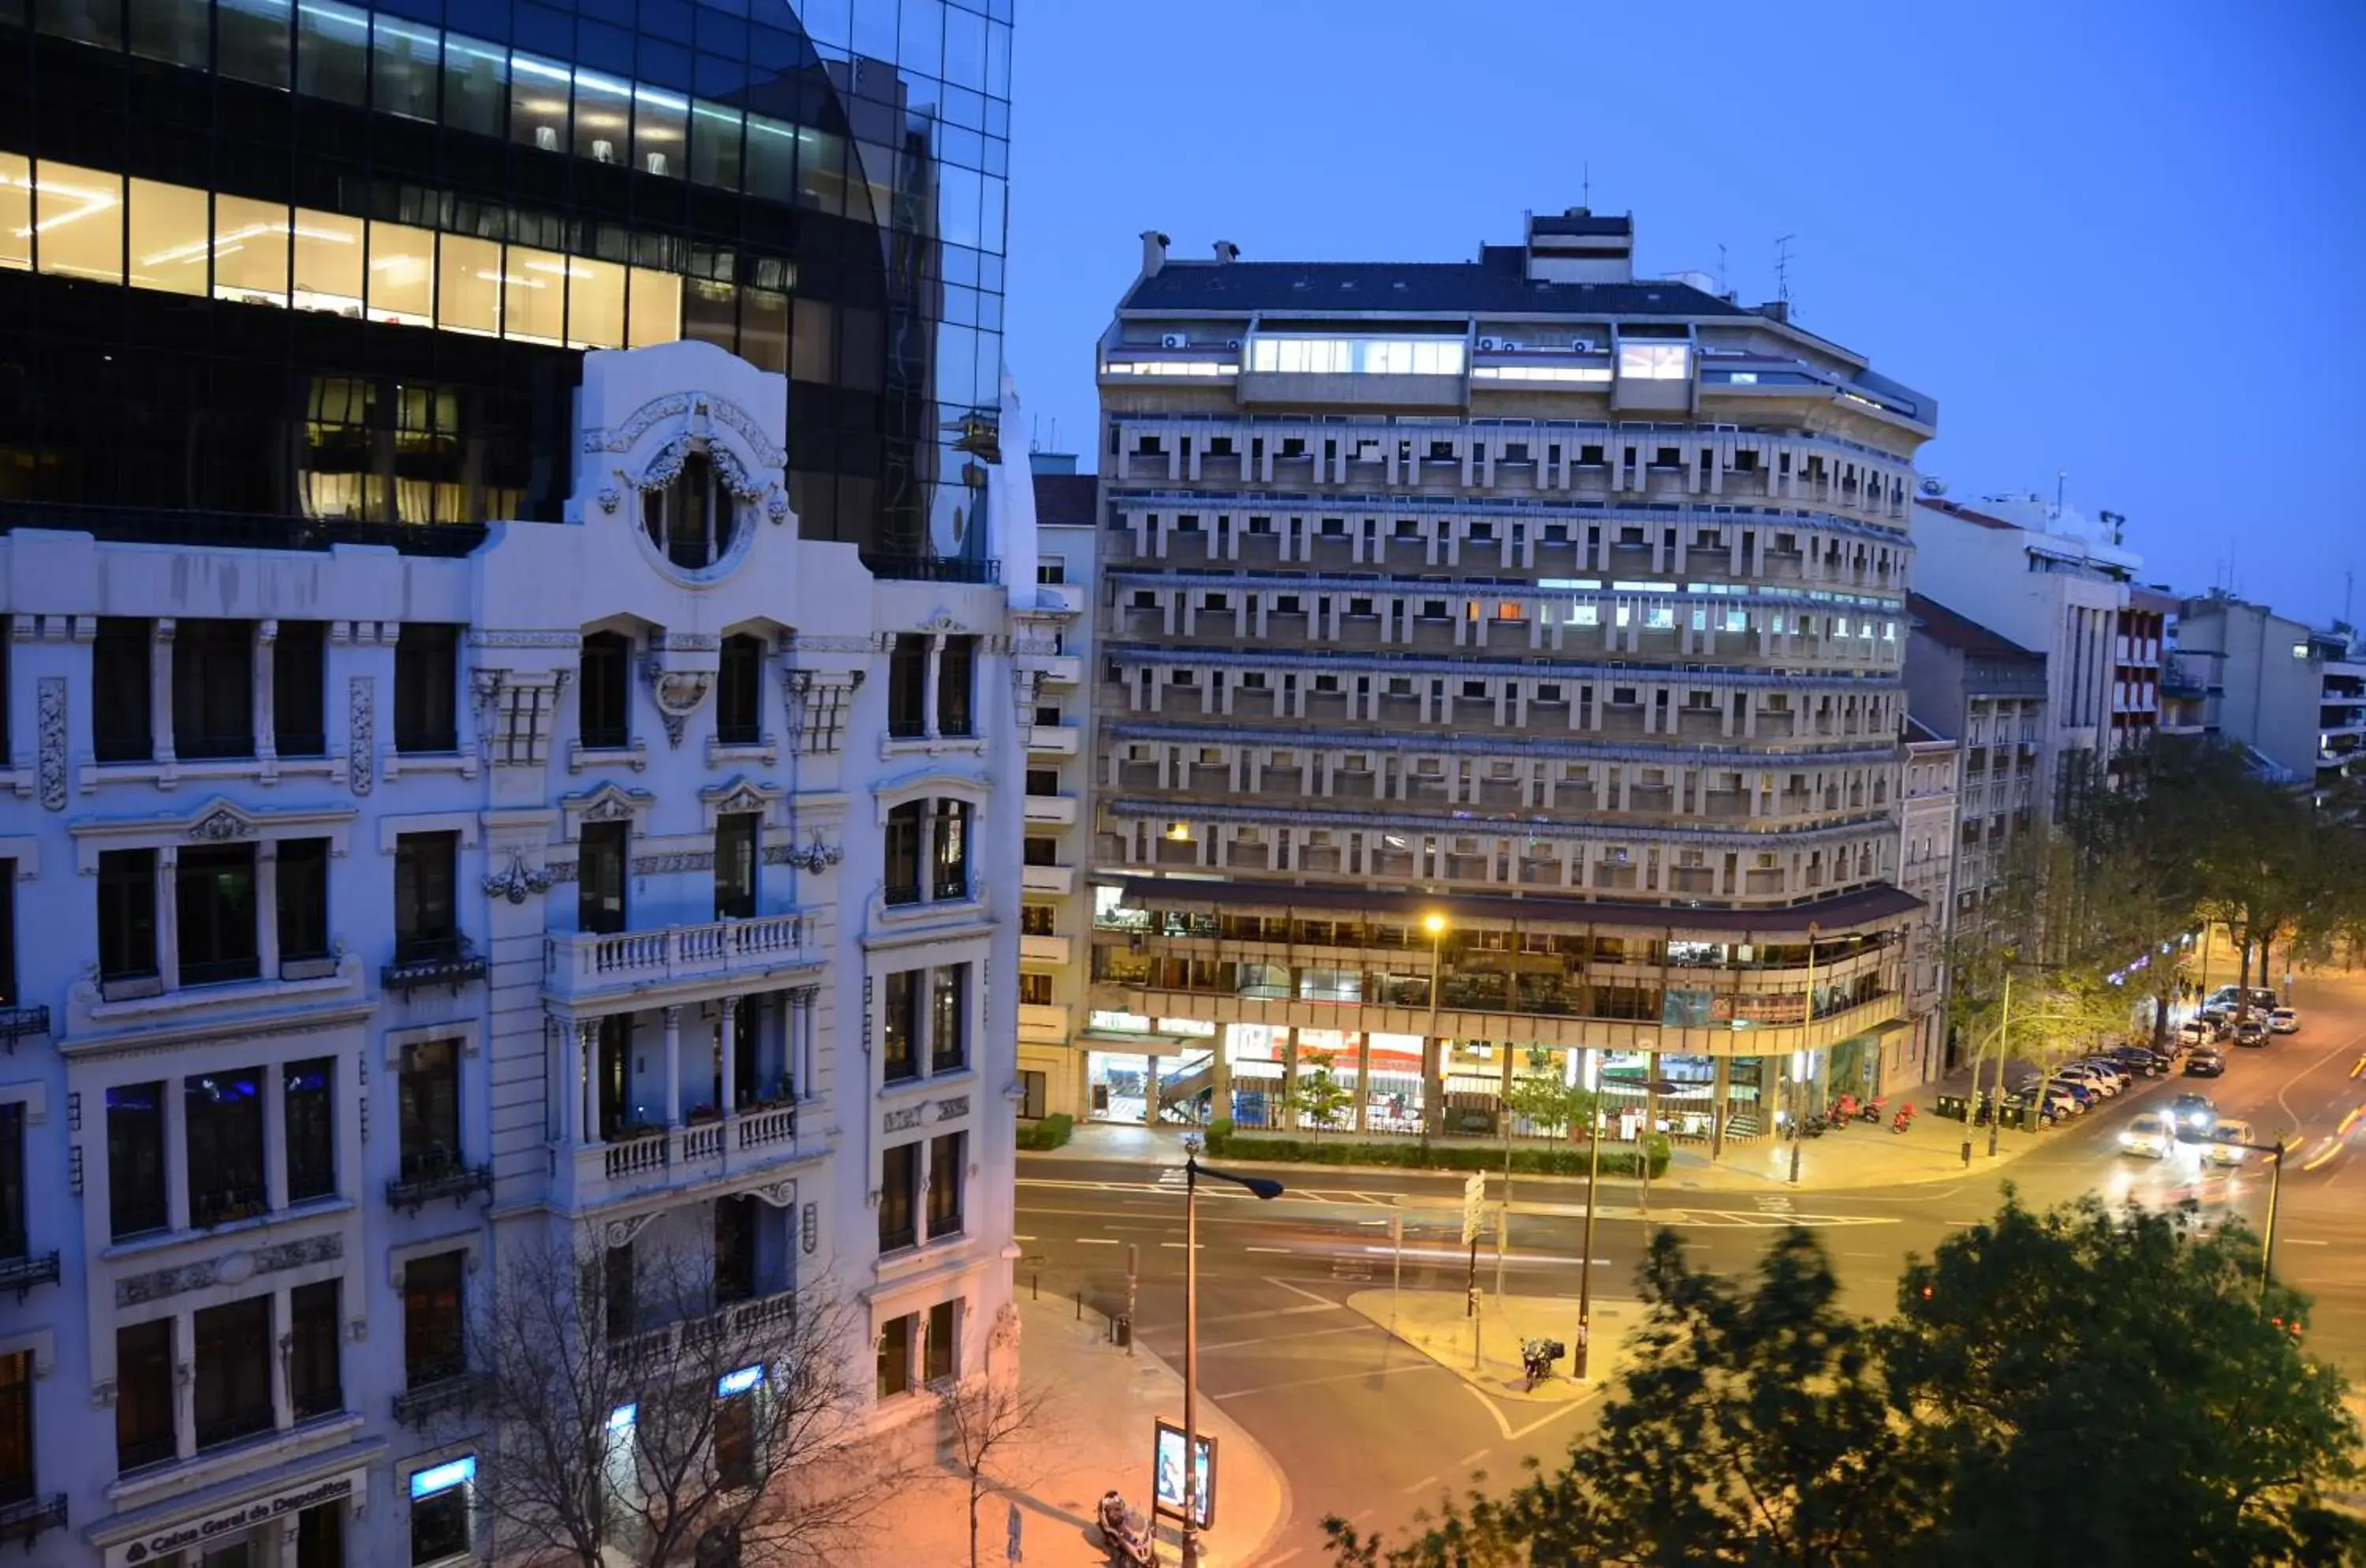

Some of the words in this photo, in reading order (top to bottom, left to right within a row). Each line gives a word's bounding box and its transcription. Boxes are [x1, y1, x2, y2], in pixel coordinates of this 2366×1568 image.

[151, 1528, 198, 1552] Caixa
[202, 1510, 246, 1535] Geral
[249, 1504, 270, 1521] de
